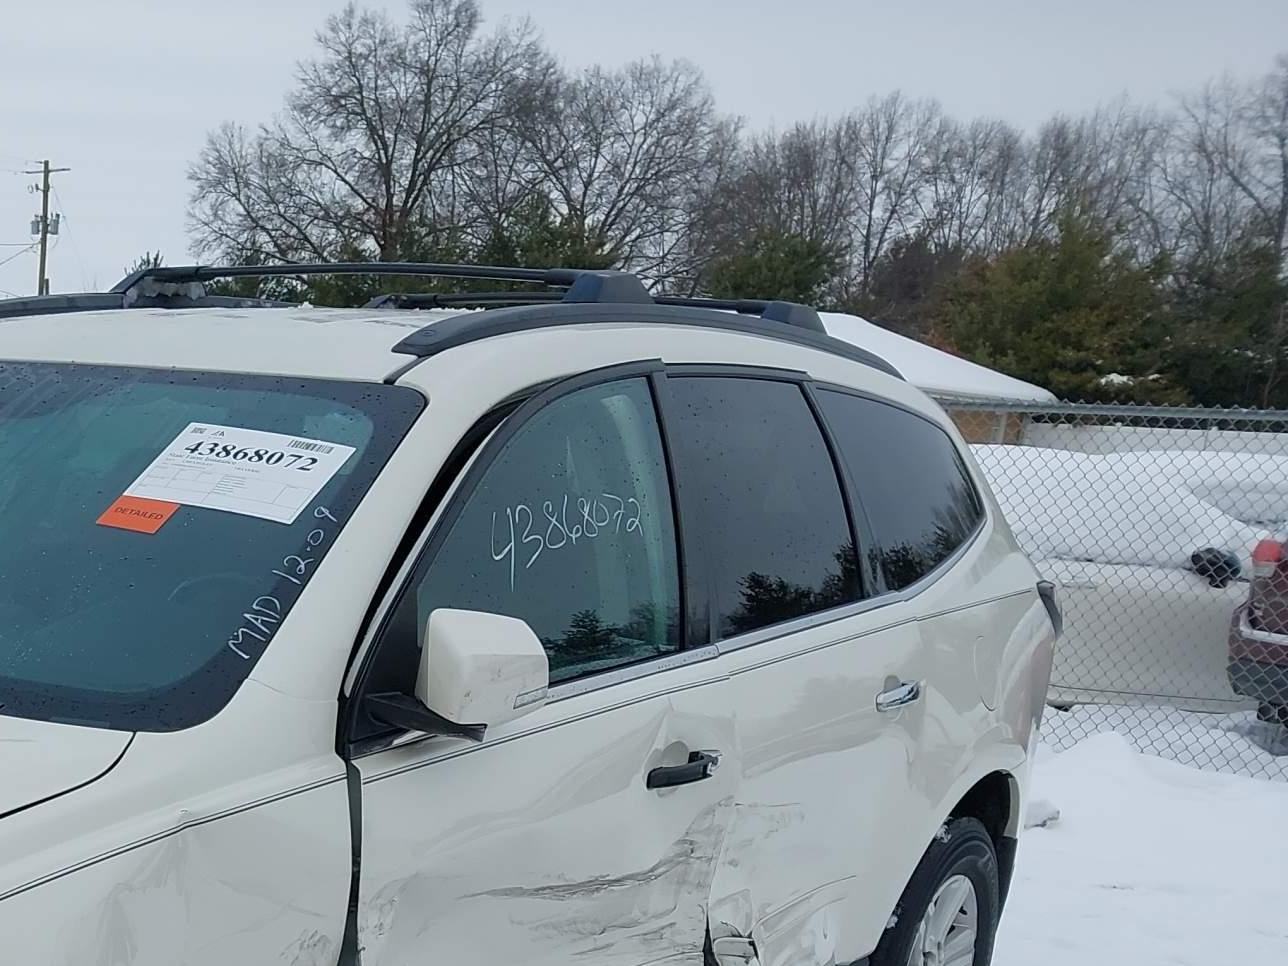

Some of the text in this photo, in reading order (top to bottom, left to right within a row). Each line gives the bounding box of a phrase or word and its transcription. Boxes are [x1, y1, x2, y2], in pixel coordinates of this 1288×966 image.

[184, 440, 319, 471] 43868072
[114, 506, 164, 520] DETAILED
[491, 493, 644, 592] 43868072
[227, 595, 281, 660] MAD
